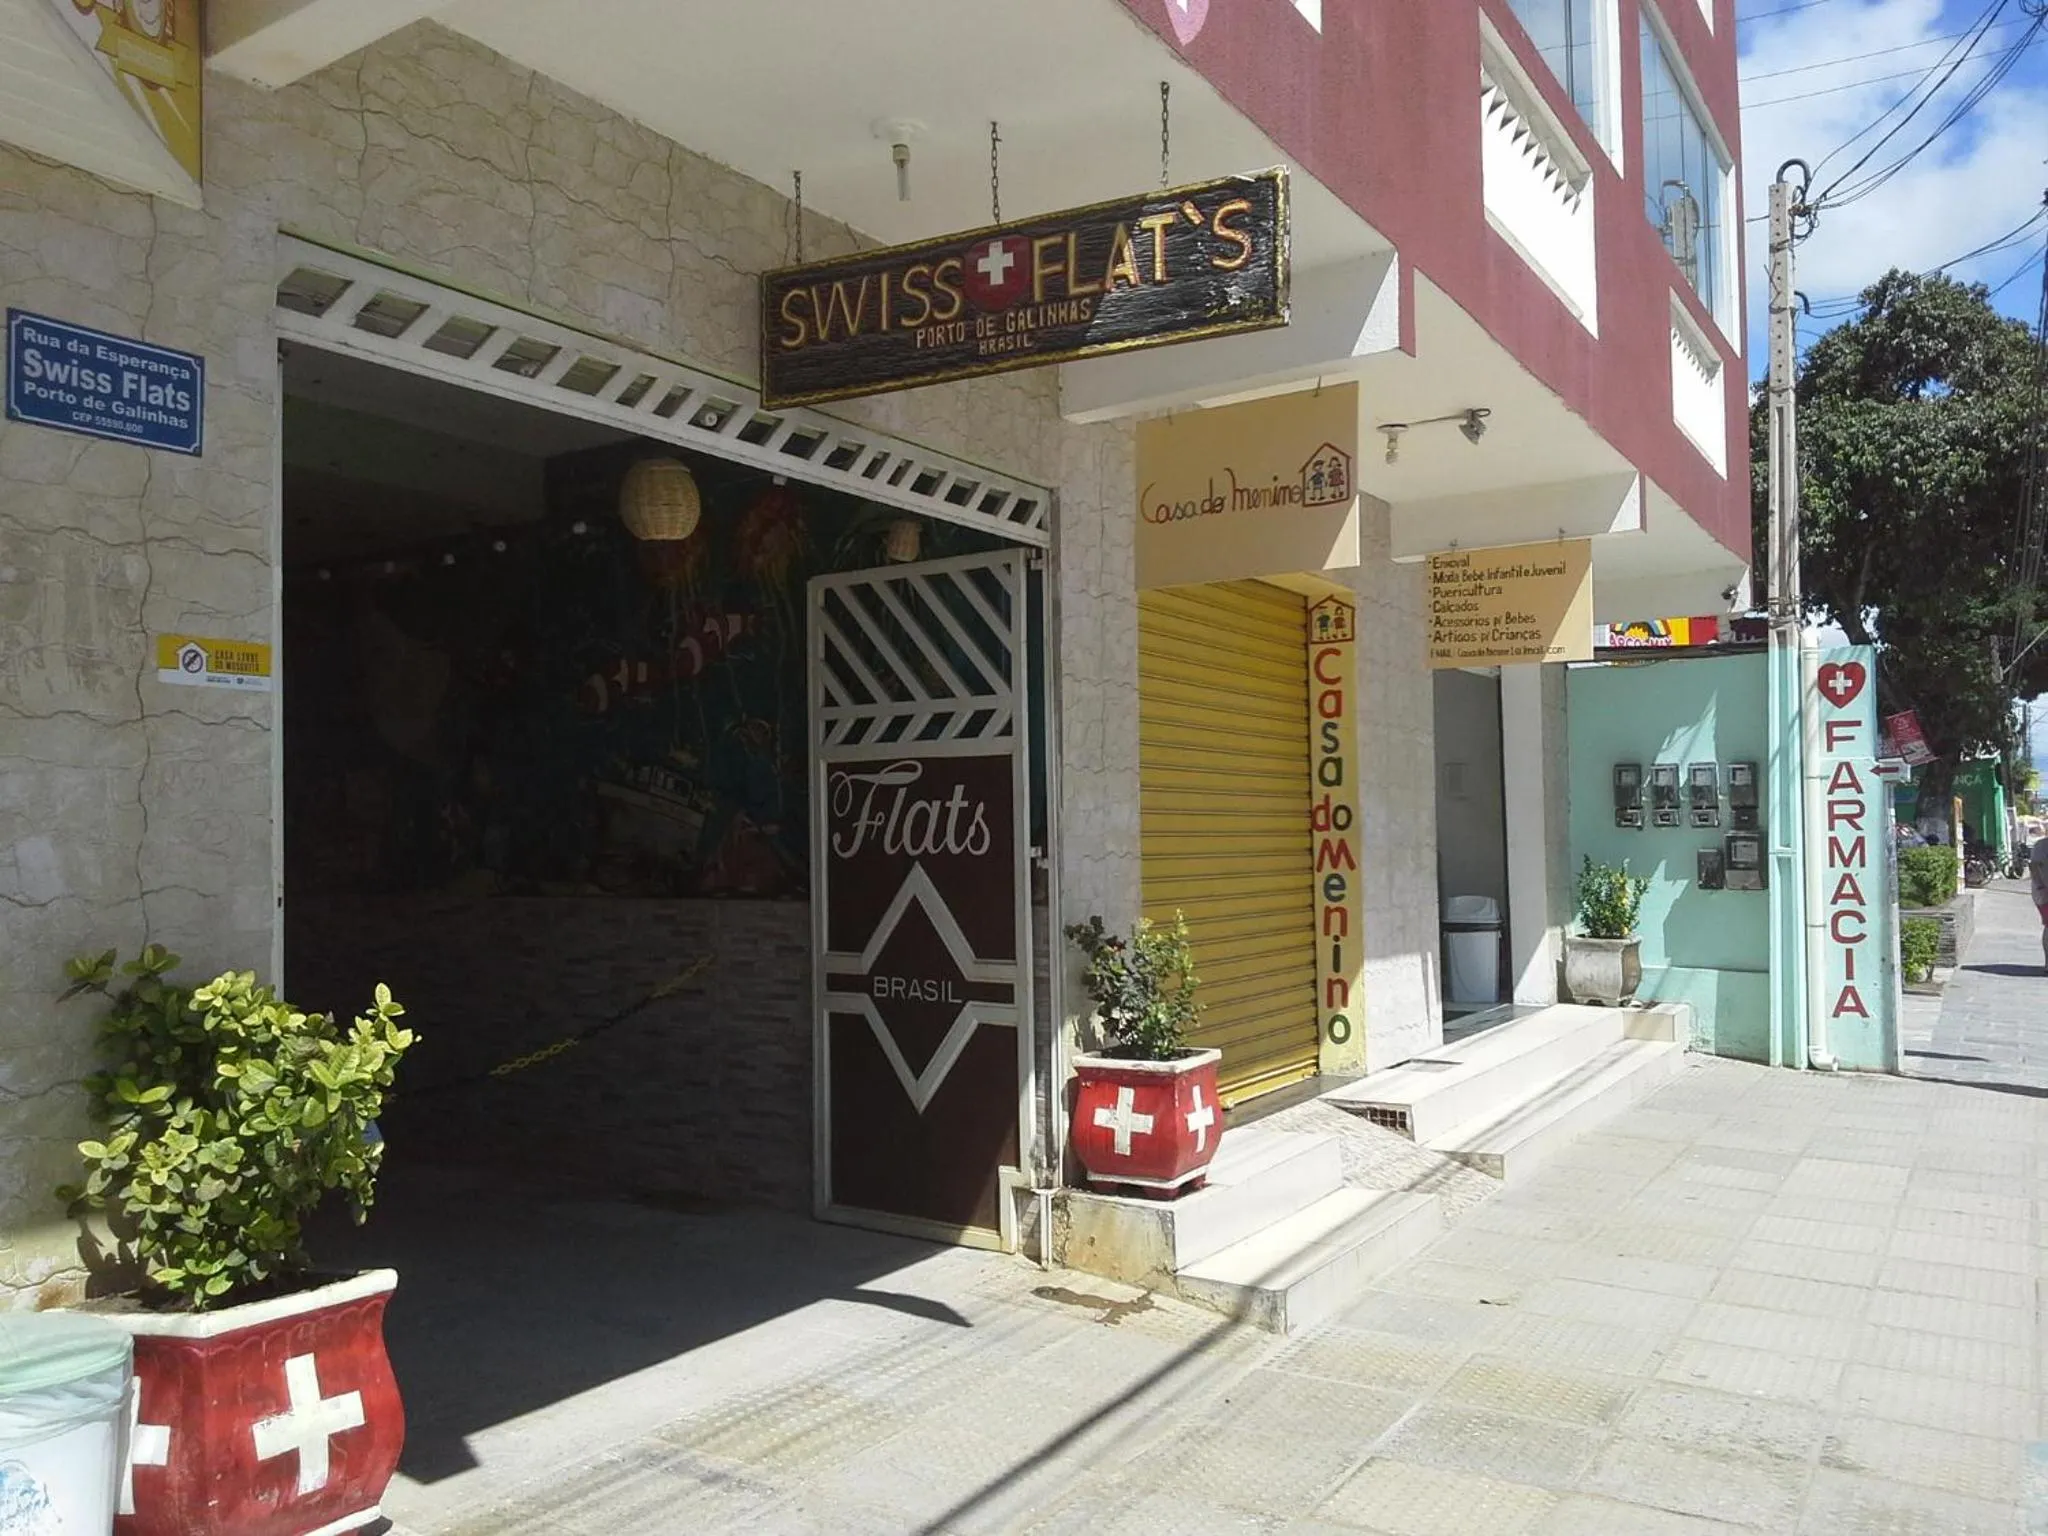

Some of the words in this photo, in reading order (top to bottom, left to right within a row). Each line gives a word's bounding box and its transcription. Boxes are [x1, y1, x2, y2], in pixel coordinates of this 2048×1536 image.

[780, 256, 964, 349] SWISS
[916, 321, 966, 349] PORTO
[976, 316, 997, 338] DE
[1006, 298, 1092, 333] GALINHAS
[23, 327, 61, 349] Rua
[67, 339, 90, 356] da
[96, 345, 191, 381] Esperança
[979, 333, 1034, 356] BRASIL
[23, 348, 113, 395] Swiss
[122, 371, 191, 412] Flats
[23, 381, 76, 405] Porto
[83, 395, 106, 411] de
[112, 401, 189, 430] Galinhas
[72, 411, 93, 423] CEP
[1140, 481, 1199, 524] Casa
[1432, 554, 1470, 570] Enxoval
[1432, 571, 1459, 585] Moda
[1487, 564, 1523, 581] Infantil
[1523, 568, 1530, 577] e
[1530, 560, 1567, 577] Juvenil
[1432, 583, 1503, 598] Puericultura
[1432, 630, 1478, 643] Artigos
[1491, 626, 1542, 642] Crianças
[1313, 647, 1343, 787] Casa
[829, 760, 992, 860] Flats
[1311, 794, 1353, 832] do
[1825, 720, 1870, 1018] FARMACIA
[1315, 838, 1357, 1045] Menino
[873, 974, 963, 1006] BRASIL
